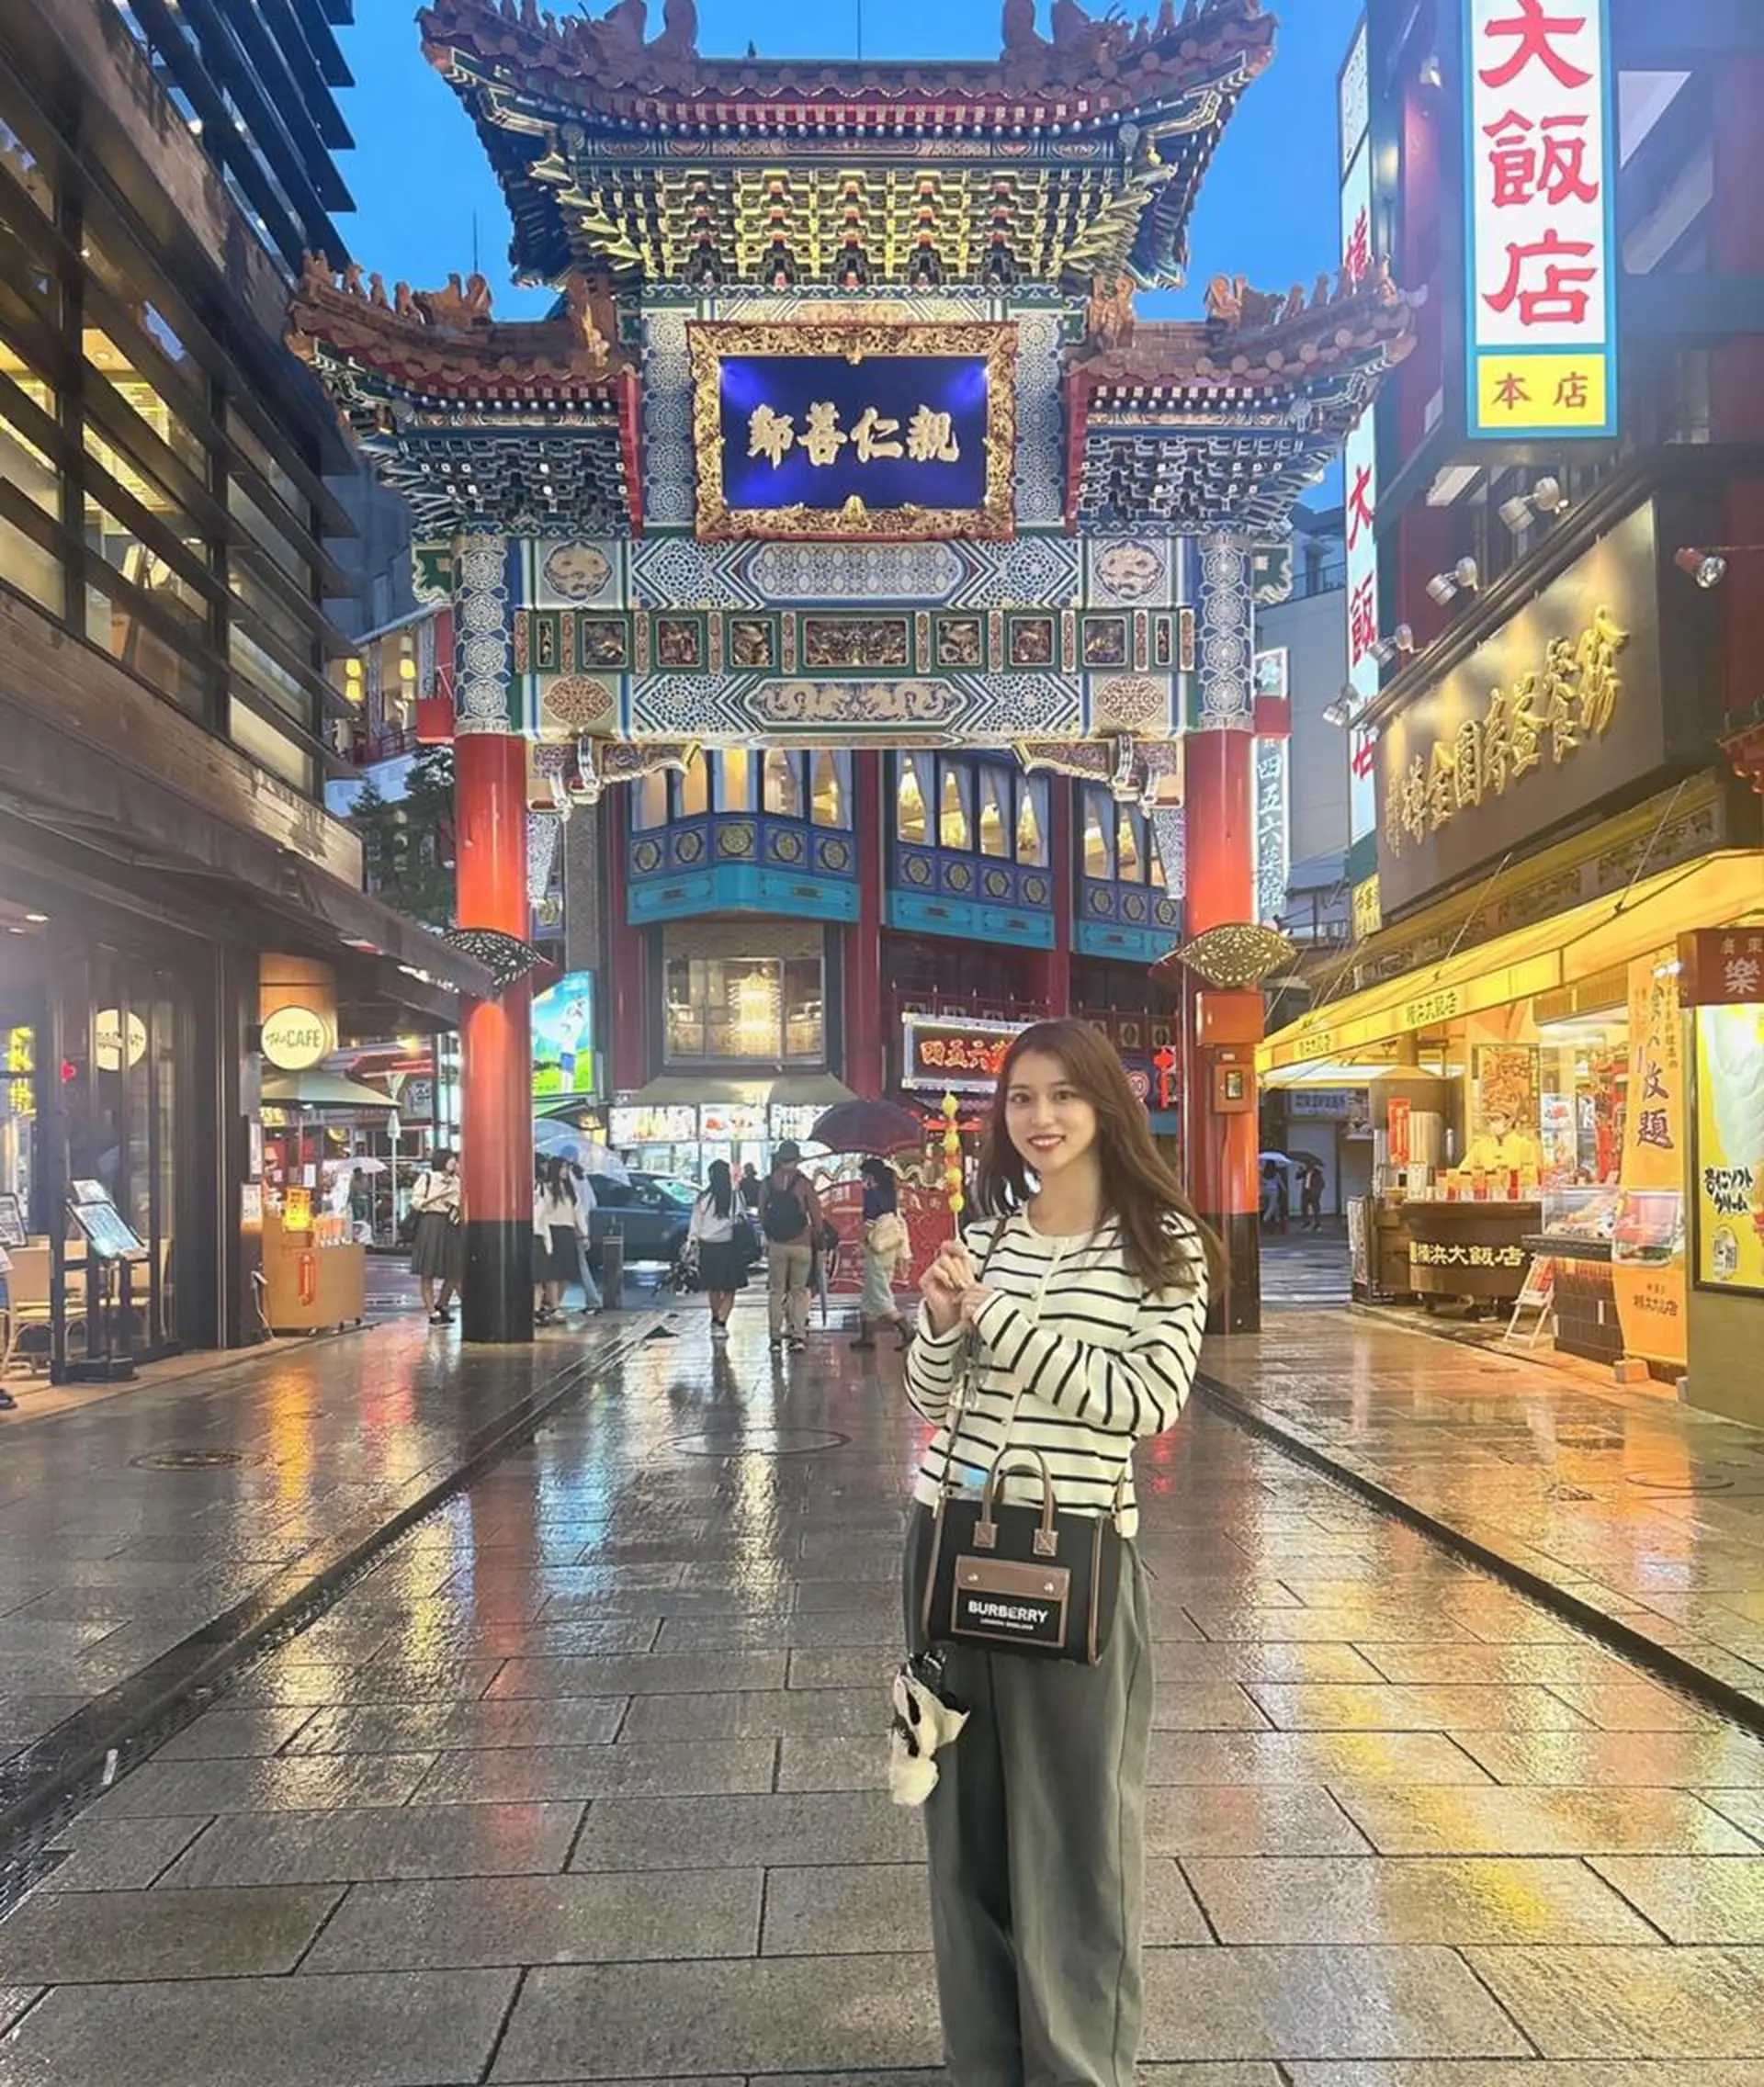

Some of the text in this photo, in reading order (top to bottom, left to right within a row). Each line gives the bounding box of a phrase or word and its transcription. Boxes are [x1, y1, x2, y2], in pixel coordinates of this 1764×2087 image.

[1477, 0, 1600, 326] 大飯店
[1491, 371, 1589, 411] 本店
[286, 1029, 321, 1048] CAFE
[967, 1599, 1048, 1624] BURBERRY
